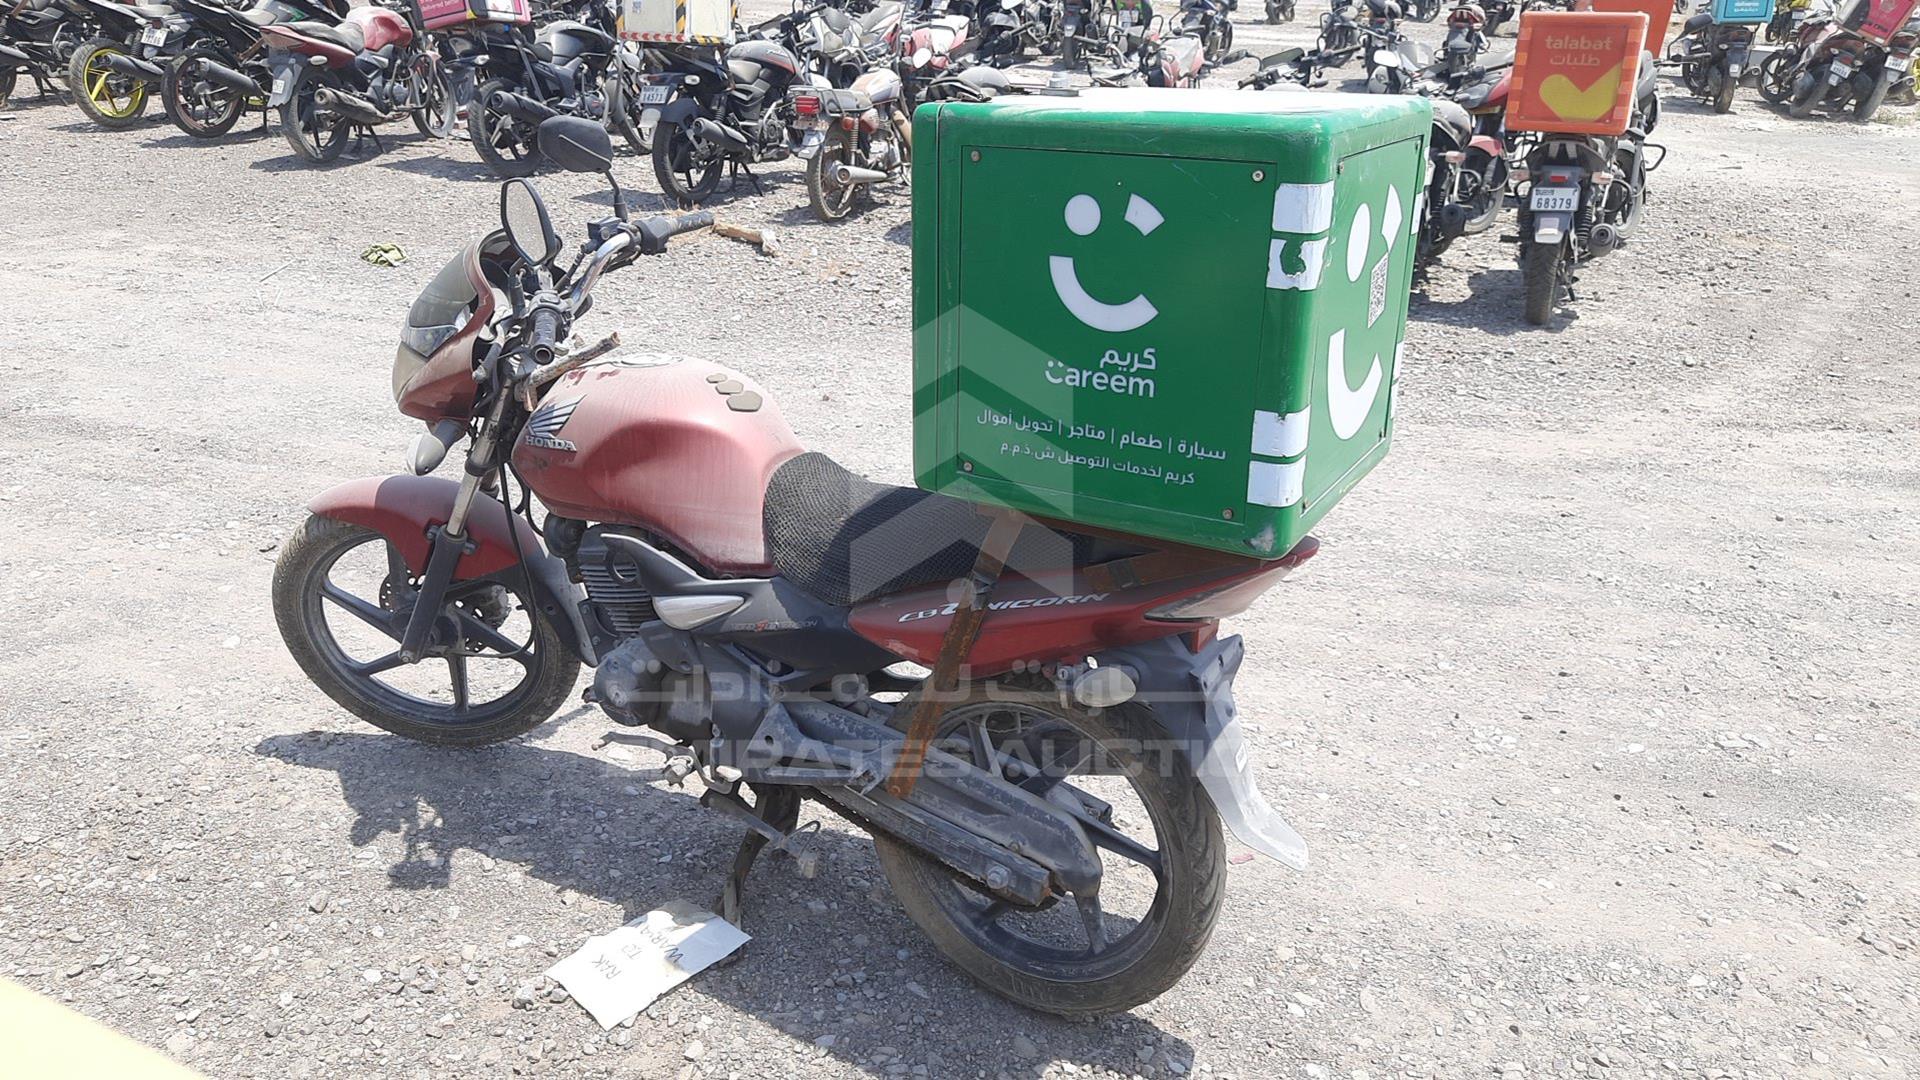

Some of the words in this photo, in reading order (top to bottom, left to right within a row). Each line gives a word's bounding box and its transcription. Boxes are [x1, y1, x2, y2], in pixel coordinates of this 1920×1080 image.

[1545, 35, 1613, 50] talabat
[1549, 53, 1601, 69] طلبات
[1536, 198, 1572, 209] 68379
[1099, 347, 1156, 373] كريم
[1045, 360, 1155, 398] Careem
[976, 409, 1013, 426] أموال
[1015, 415, 1053, 432] تحويل
[1067, 423, 1106, 441] متاجر
[1119, 431, 1163, 449] طعام
[525, 435, 577, 452] HONDA
[1177, 438, 1227, 460] سيارة
[1058, 450, 1110, 469] التوصيل
[1112, 460, 1161, 478] لخدمات
[1164, 470, 1195, 485] كريم
